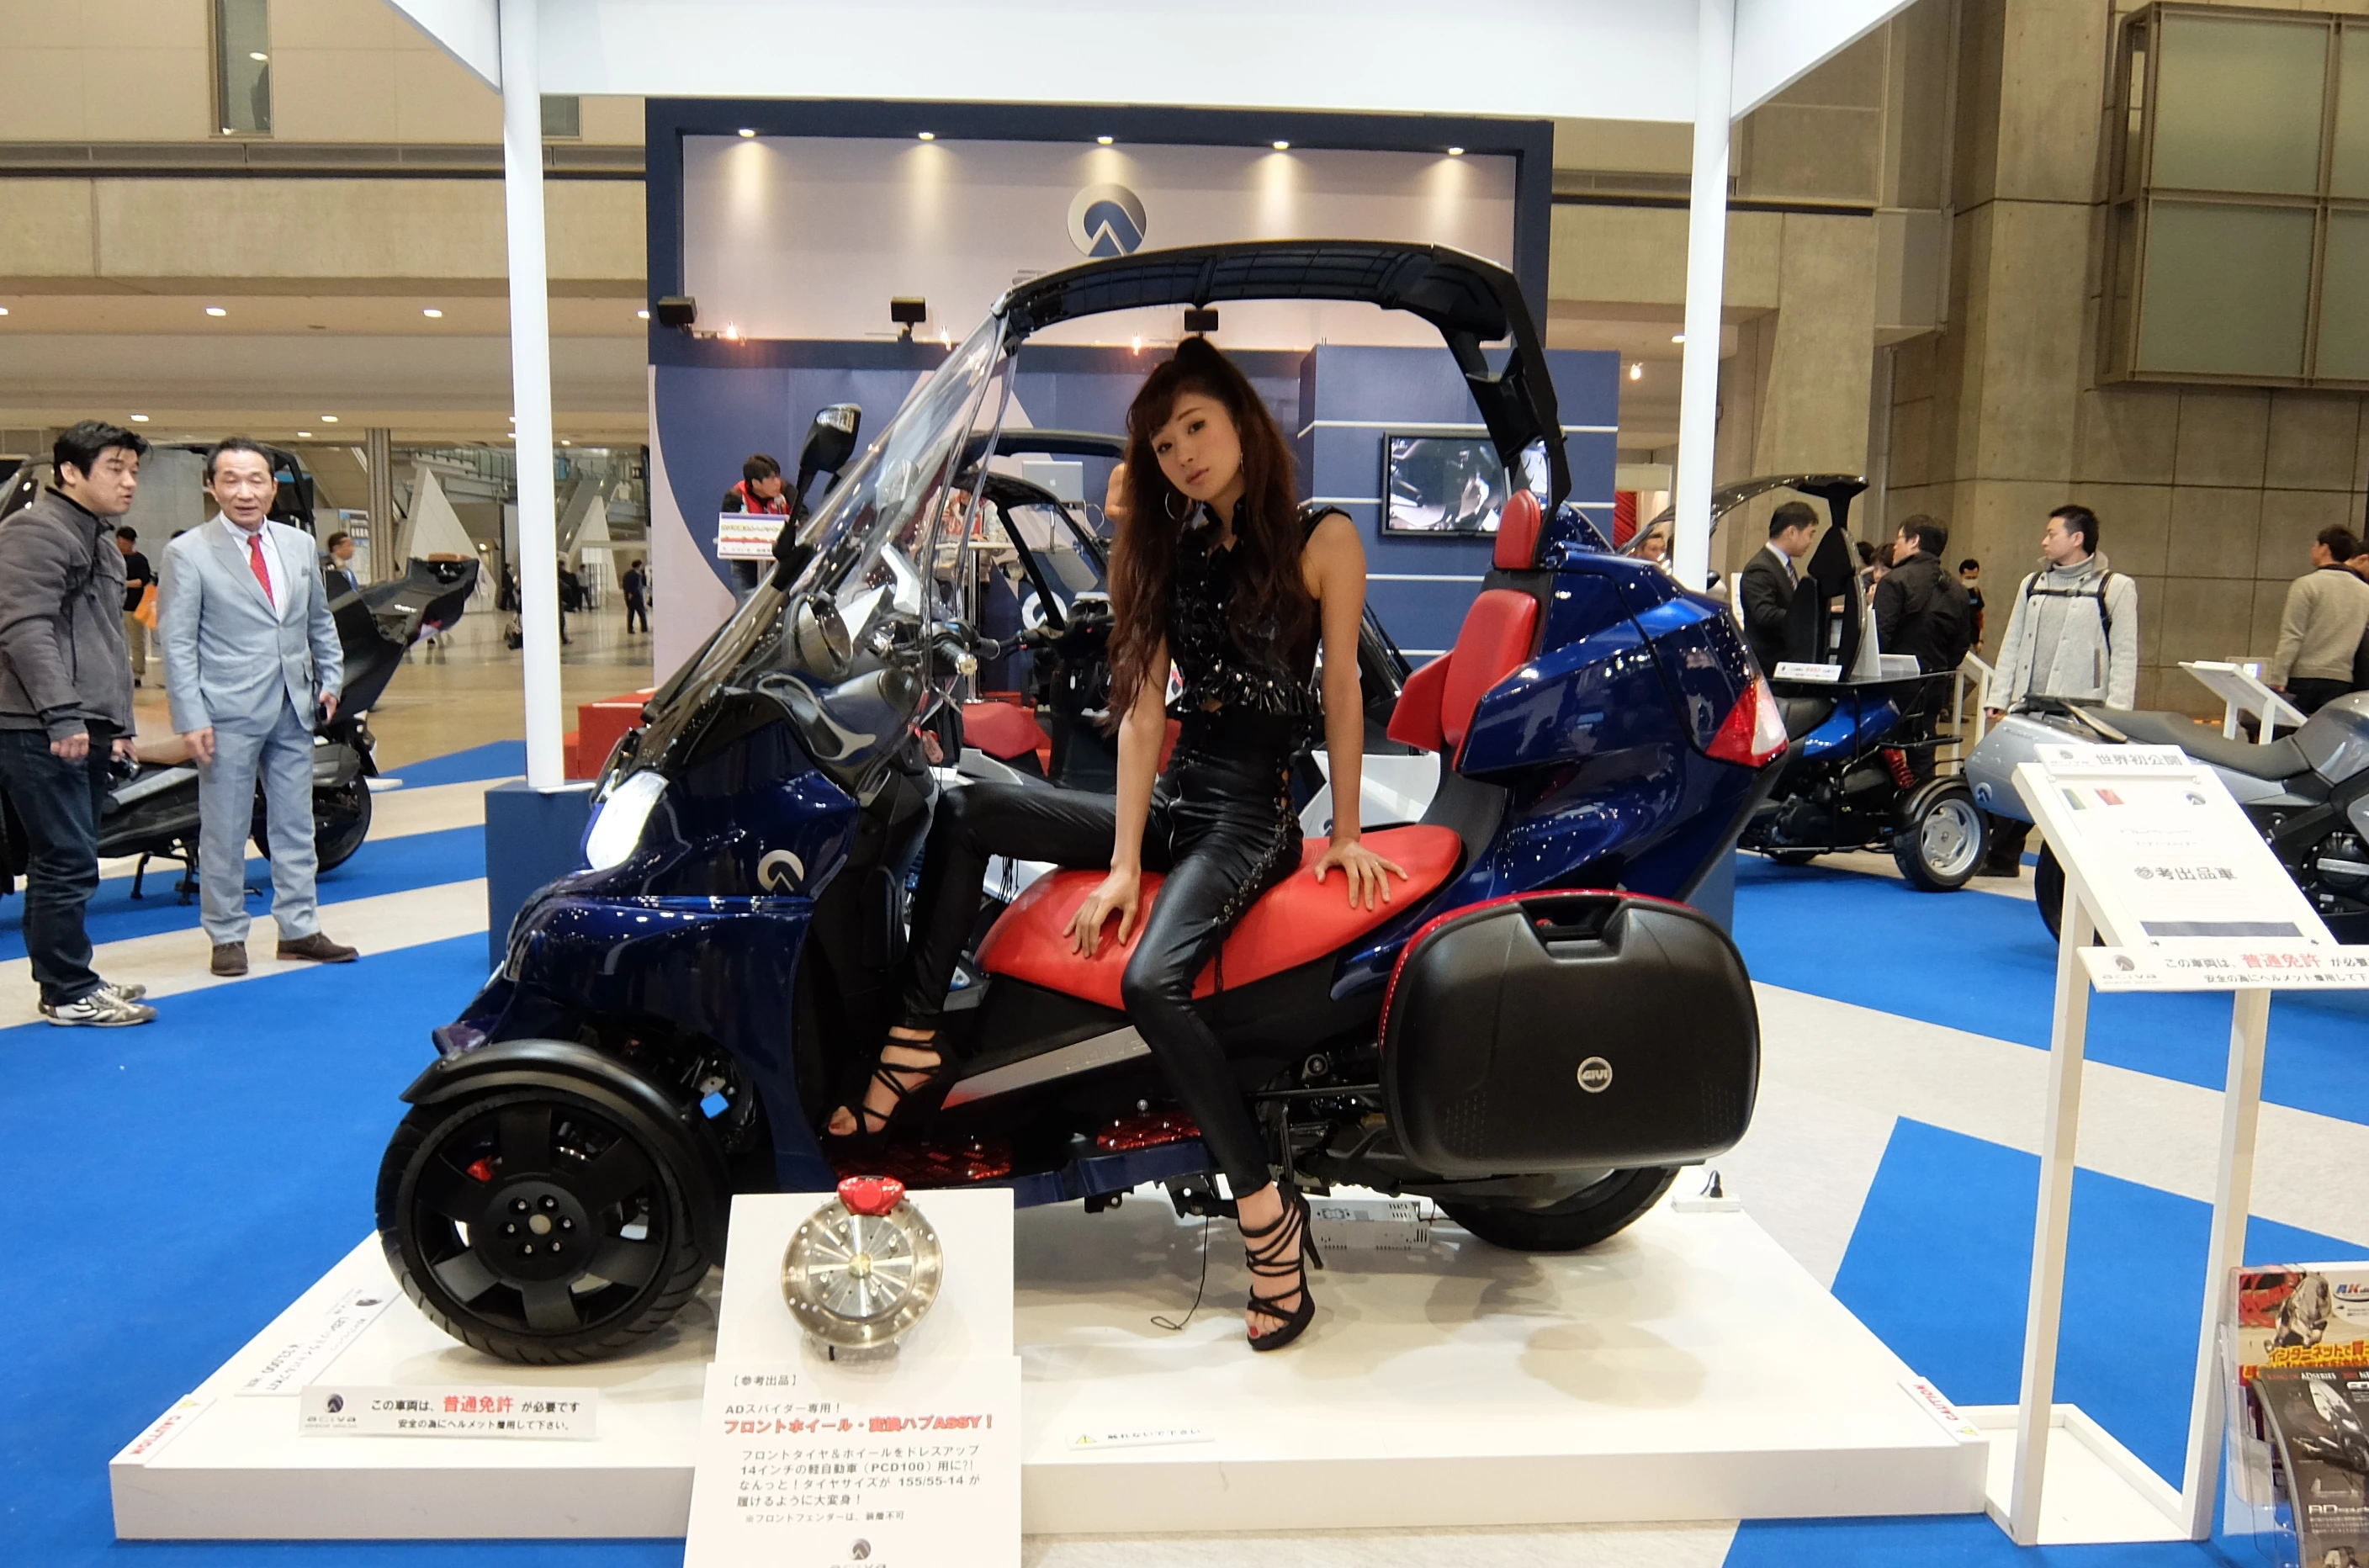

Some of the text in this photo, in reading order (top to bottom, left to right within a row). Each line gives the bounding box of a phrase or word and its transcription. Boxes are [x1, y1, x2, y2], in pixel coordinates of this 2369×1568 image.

[443, 1396, 514, 1414] 普通免許
[898, 1476, 964, 1487] 155/55-14
